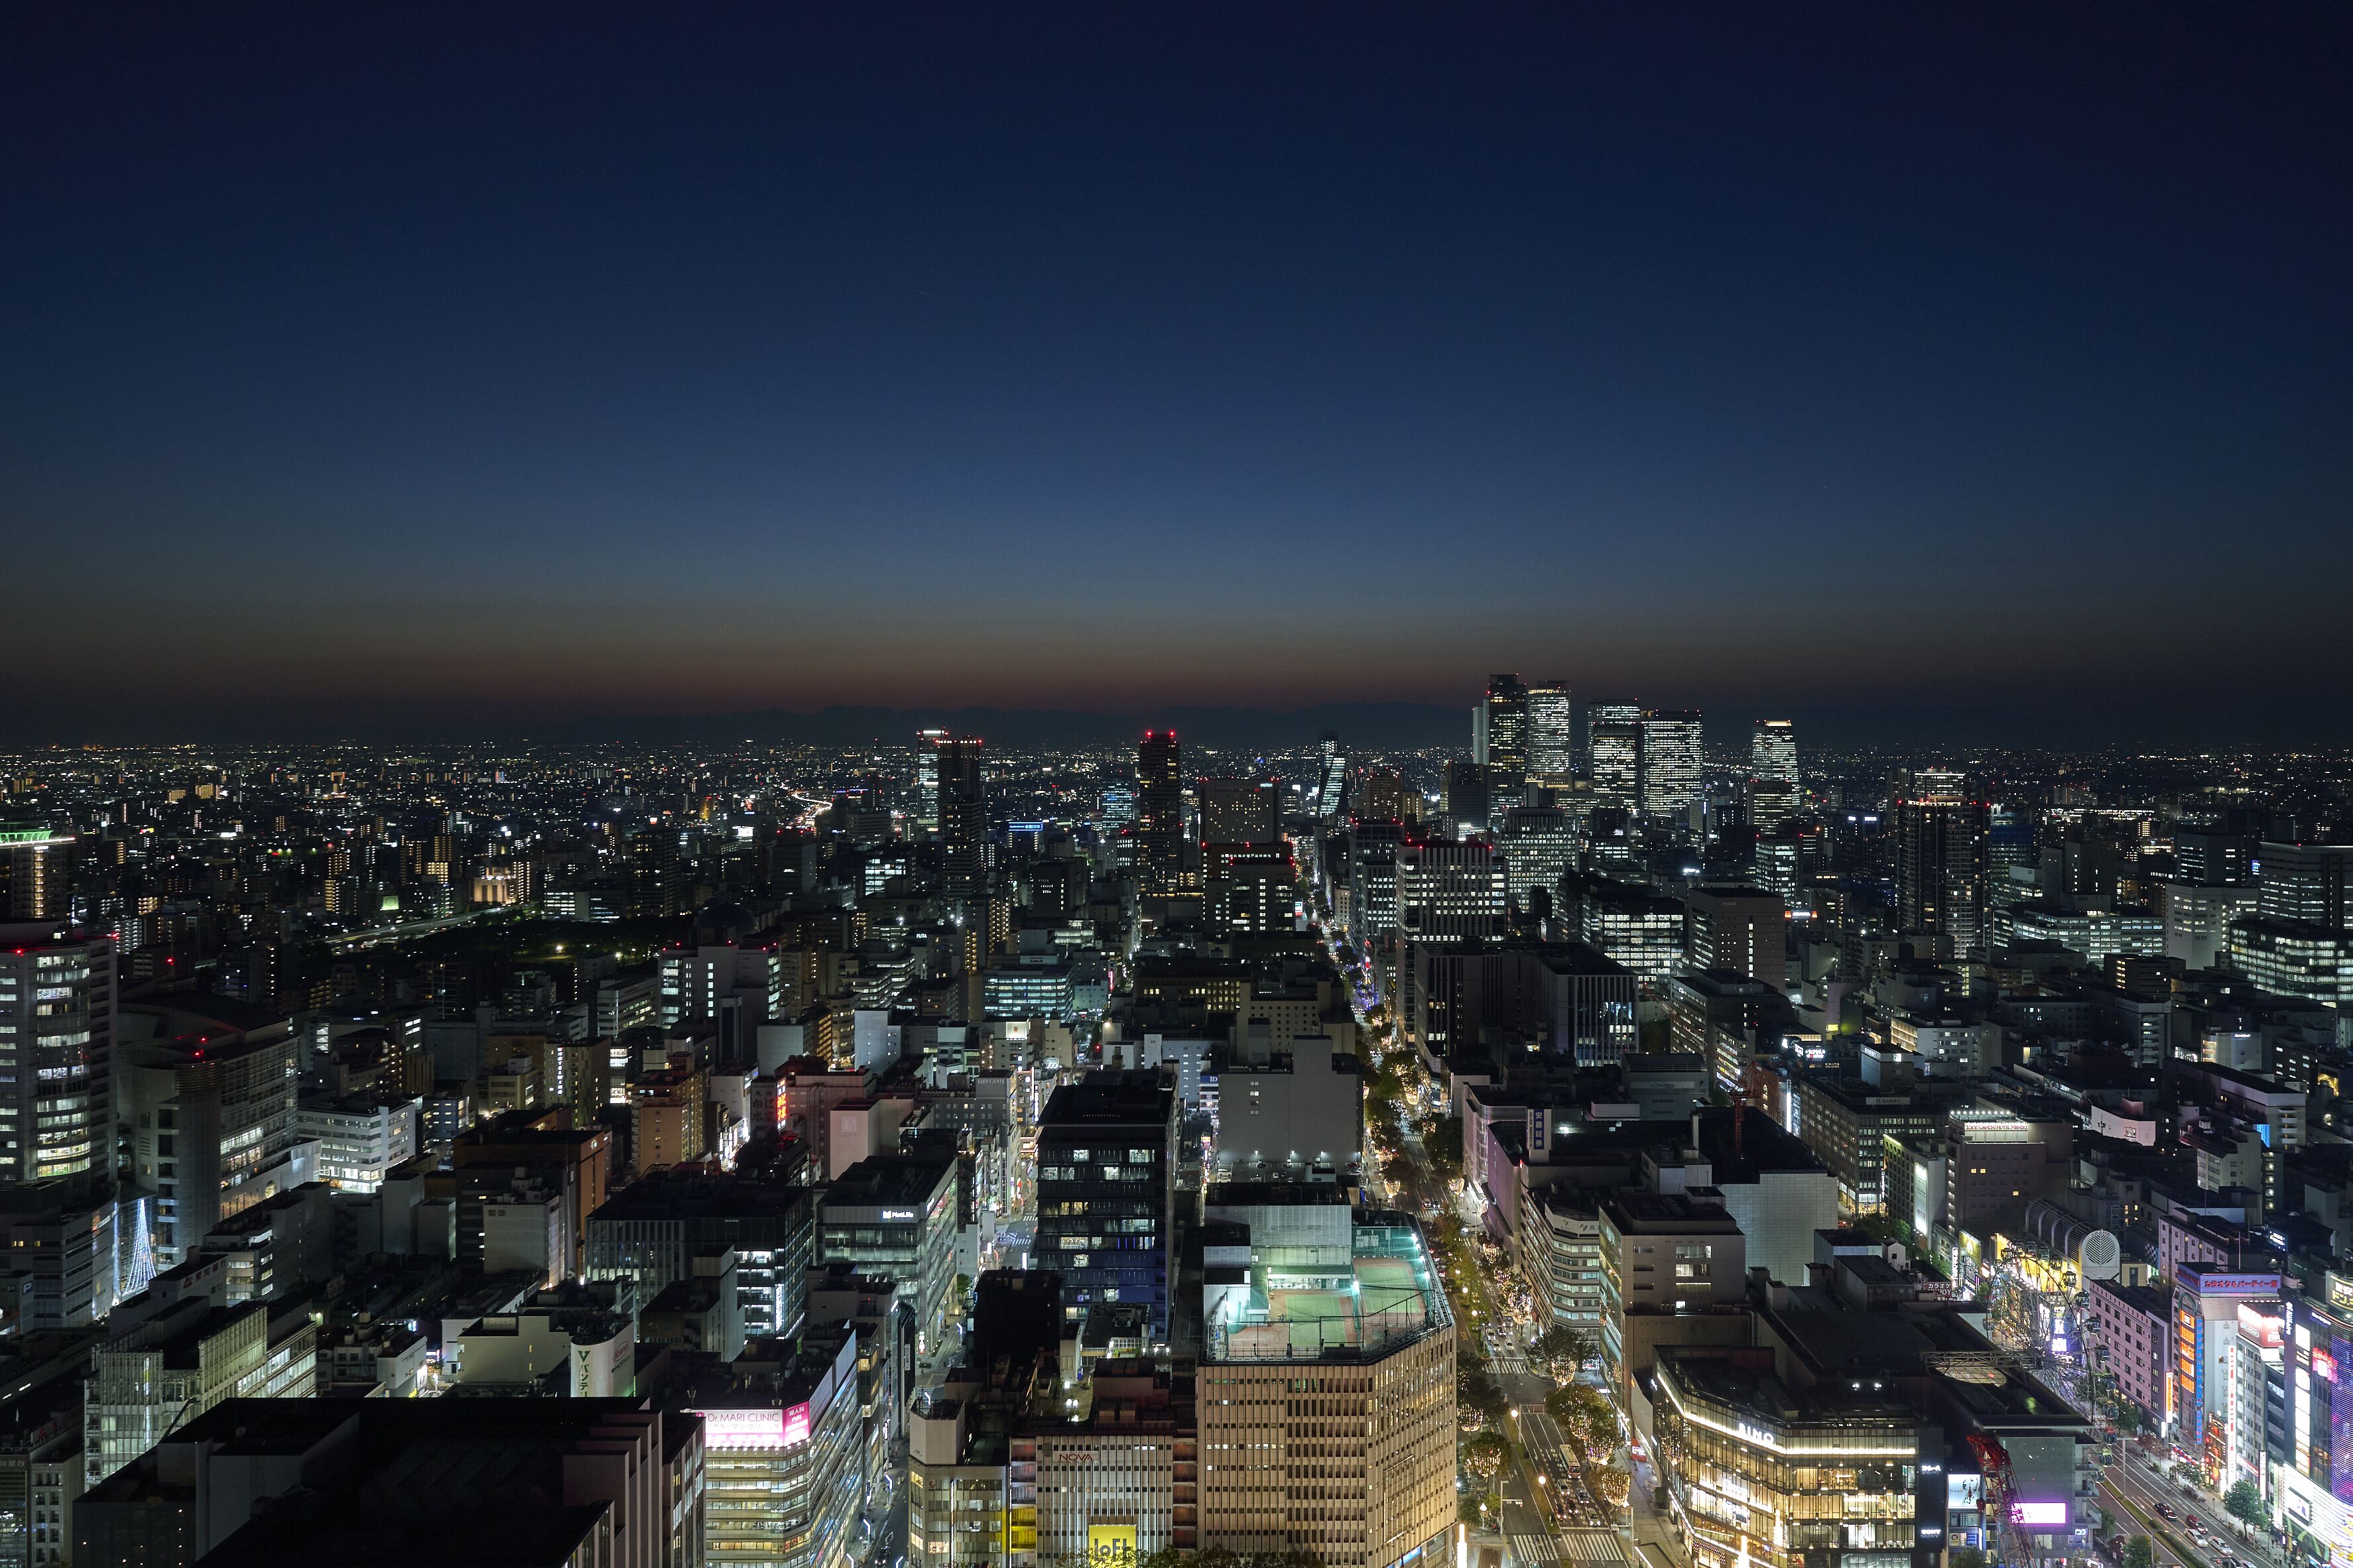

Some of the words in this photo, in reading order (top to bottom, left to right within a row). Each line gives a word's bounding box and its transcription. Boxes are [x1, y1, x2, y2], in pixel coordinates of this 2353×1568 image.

[23, 1282, 32, 1294] P
[748, 1414, 780, 1422] CLINIC
[1738, 1422, 1775, 1443] BINO
